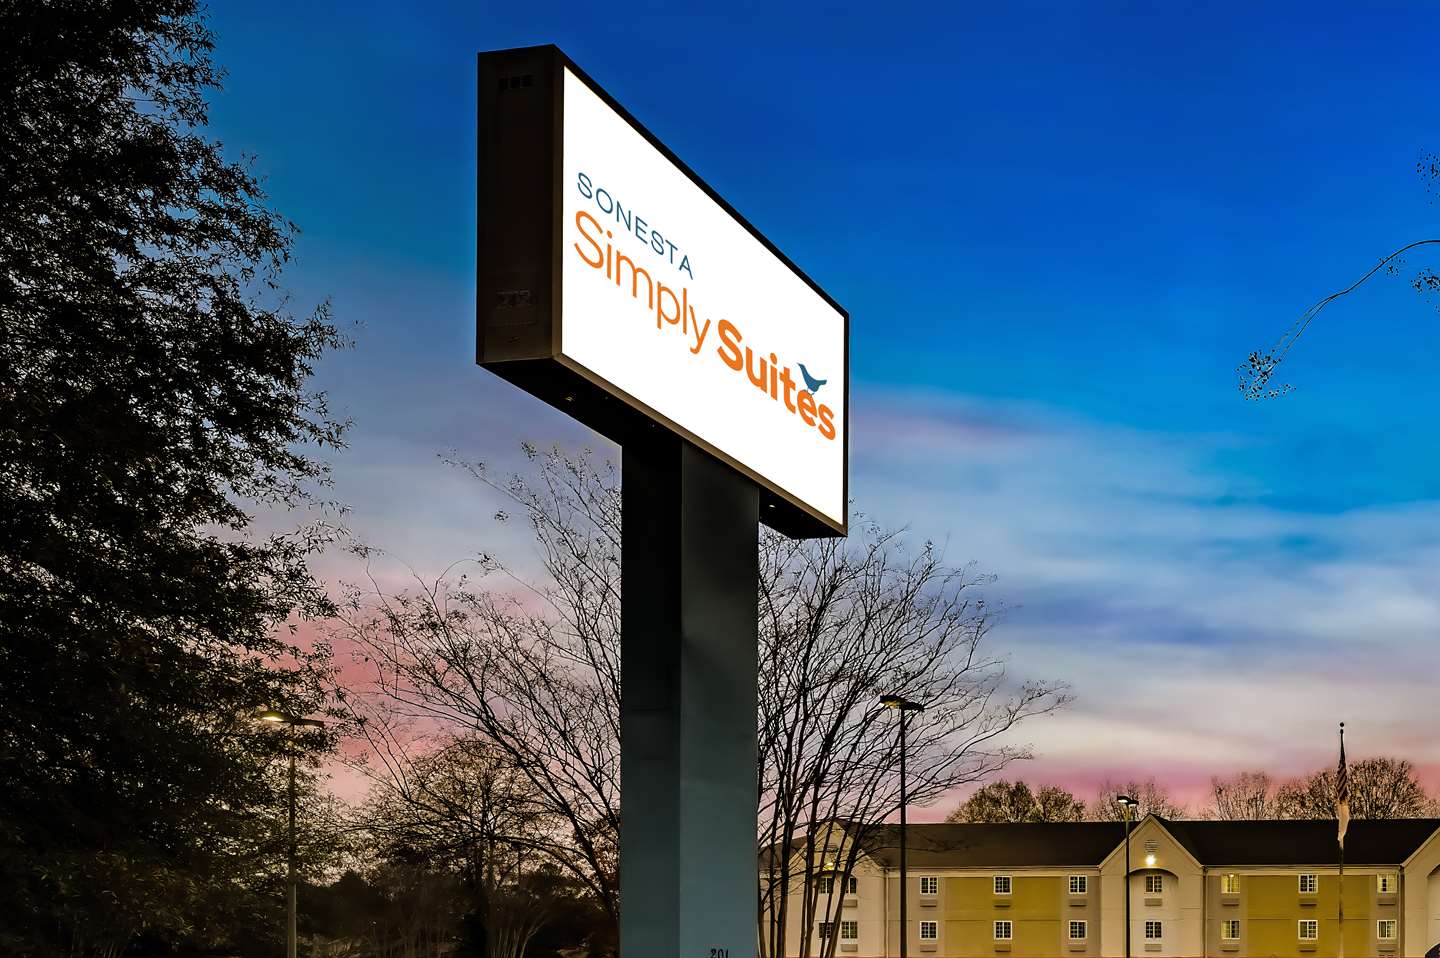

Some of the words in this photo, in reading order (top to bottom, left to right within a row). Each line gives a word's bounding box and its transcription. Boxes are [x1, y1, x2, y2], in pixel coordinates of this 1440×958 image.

[577, 172, 694, 280] SONESTA
[574, 210, 711, 356] Simply
[716, 318, 837, 441] Suites
